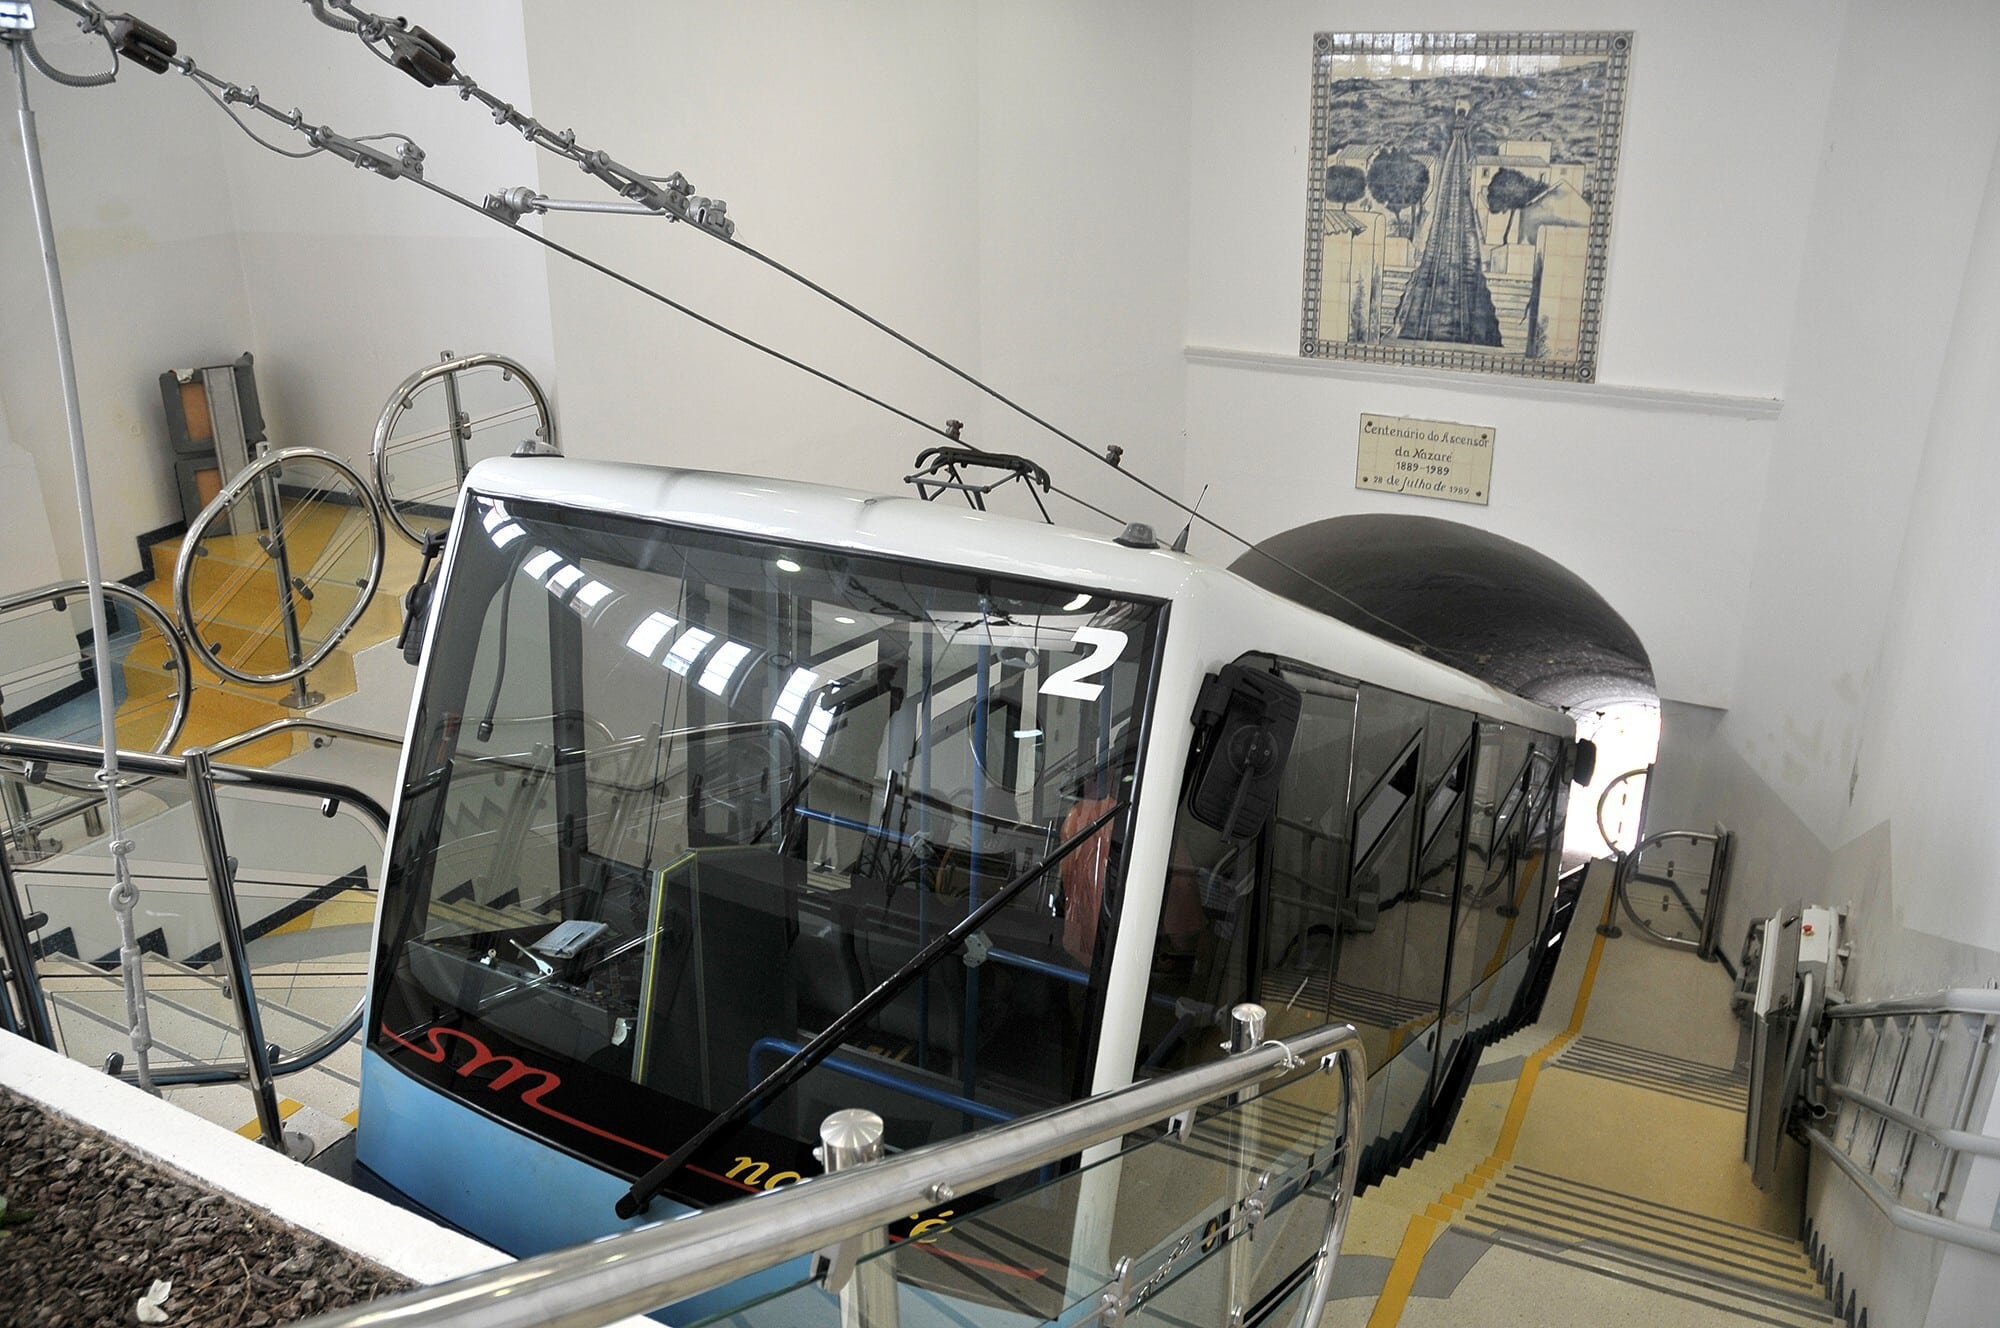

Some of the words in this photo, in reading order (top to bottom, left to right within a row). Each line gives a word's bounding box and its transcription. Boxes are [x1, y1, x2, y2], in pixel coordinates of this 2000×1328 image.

[1427, 430, 1439, 442] do
[1440, 431, 1489, 448] Ascensor
[1395, 446, 1410, 457] da
[1412, 448, 1453, 462] Nazaré
[1397, 461, 1450, 476] 1889-1989
[1374, 475, 1383, 484] 28
[1386, 474, 1400, 485] de
[1433, 480, 1447, 491] de
[1039, 626, 1128, 701] 2
